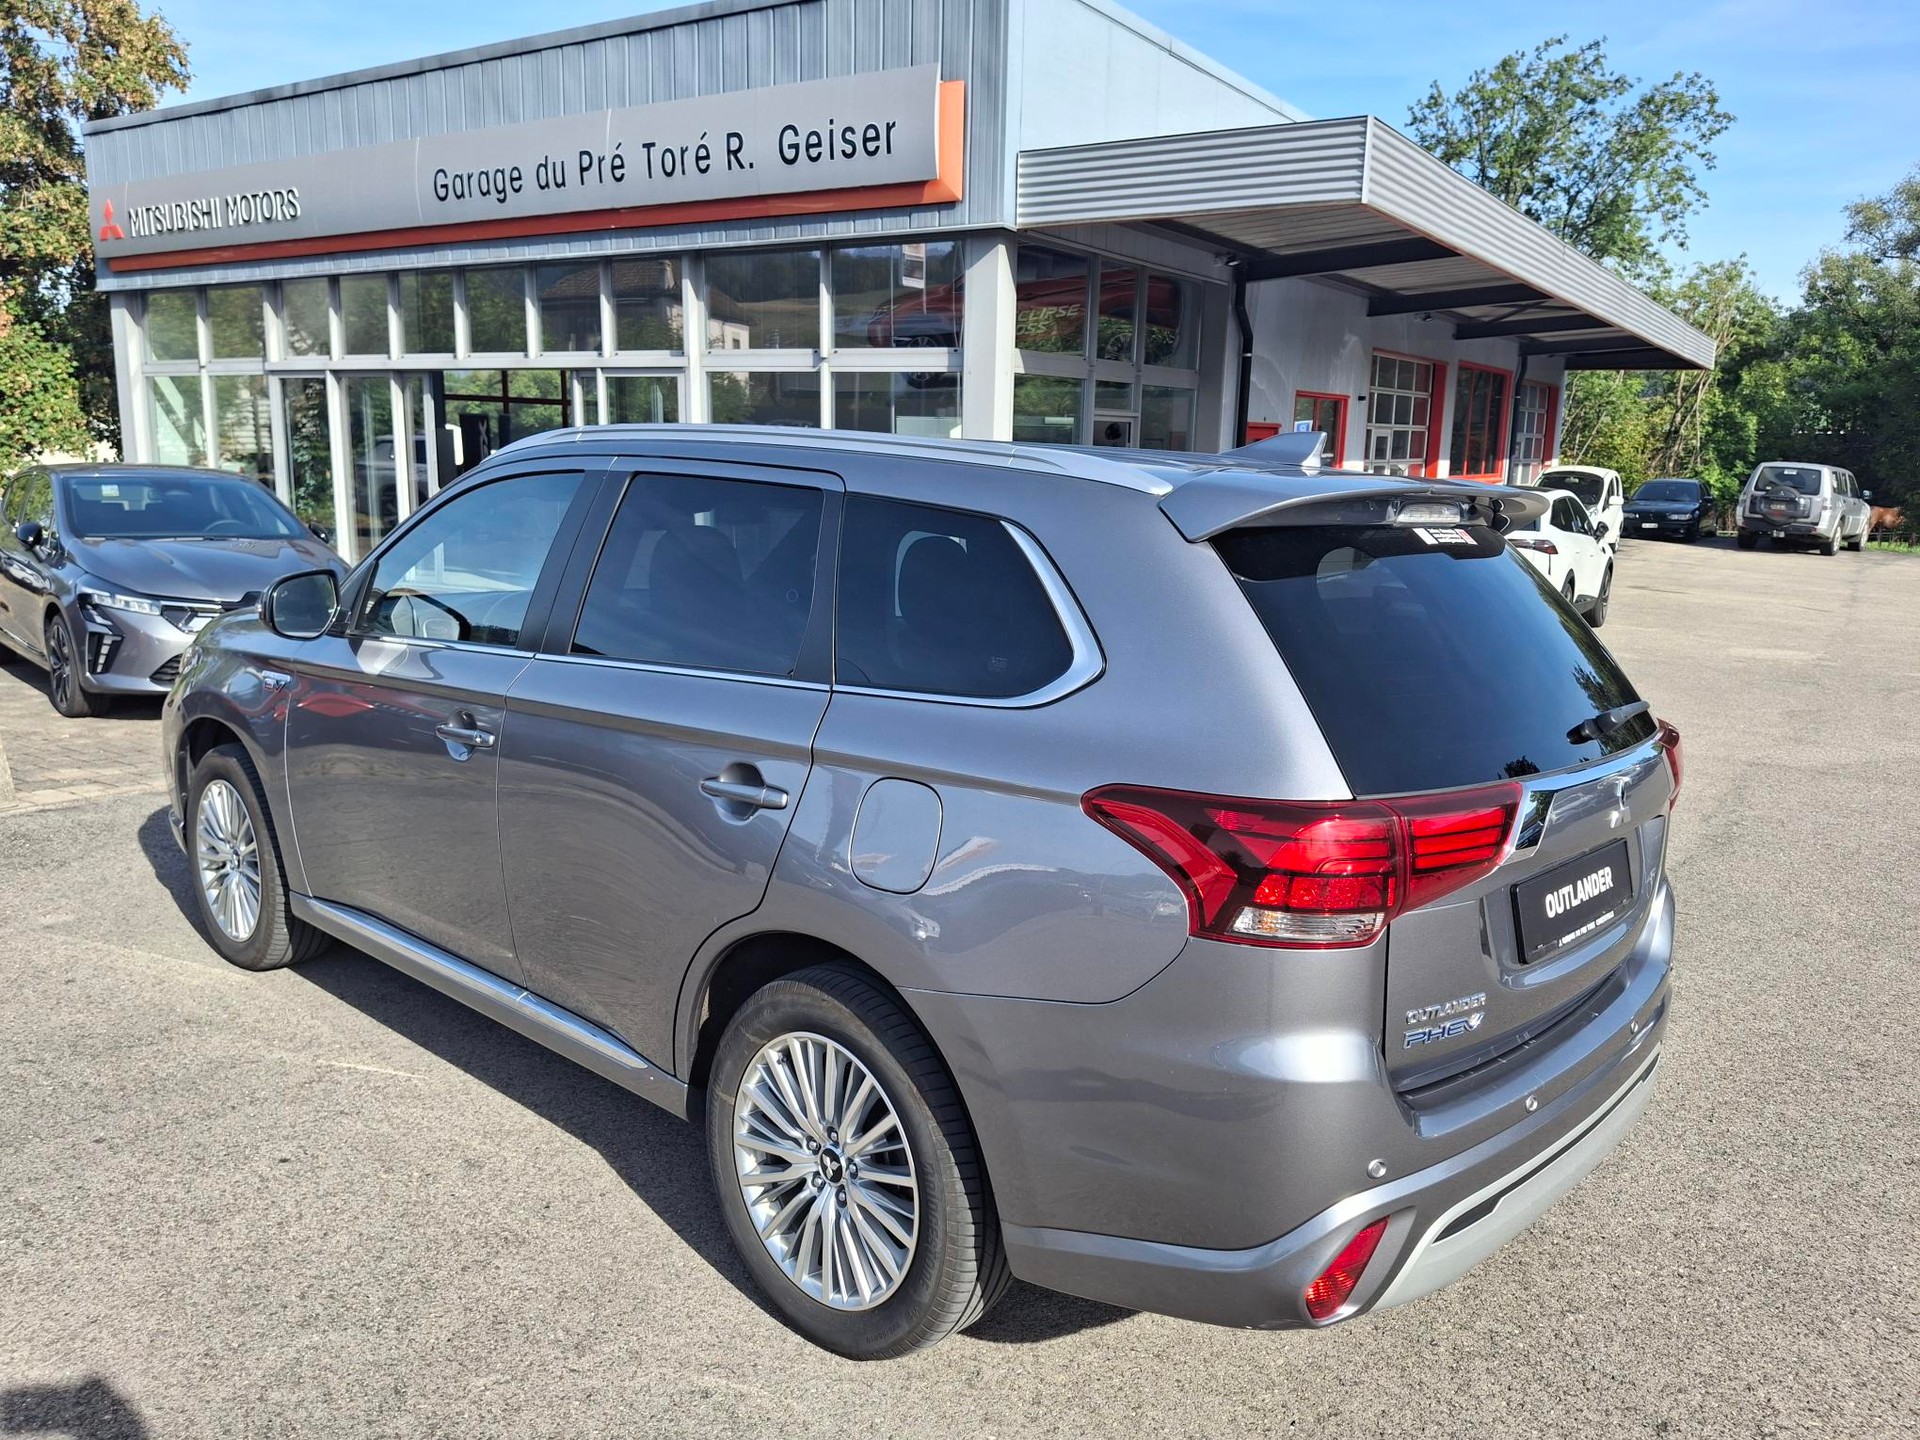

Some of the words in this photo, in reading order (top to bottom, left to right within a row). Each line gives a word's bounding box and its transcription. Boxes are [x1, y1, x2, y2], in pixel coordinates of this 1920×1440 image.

[433, 165, 523, 204] Garage
[536, 155, 566, 191] du
[578, 143, 625, 186] Pré
[641, 132, 711, 180] Toré
[725, 131, 754, 172] R.
[778, 118, 897, 165] Geiser
[128, 198, 222, 238] MITSUBISHI
[226, 188, 301, 226] MOTORS
[1017, 304, 1081, 322] CLIPSE
[1545, 866, 1614, 918] OUTLANDER
[1403, 1011, 1485, 1049] PHEV
[1405, 992, 1486, 1024] OUTLANDER
